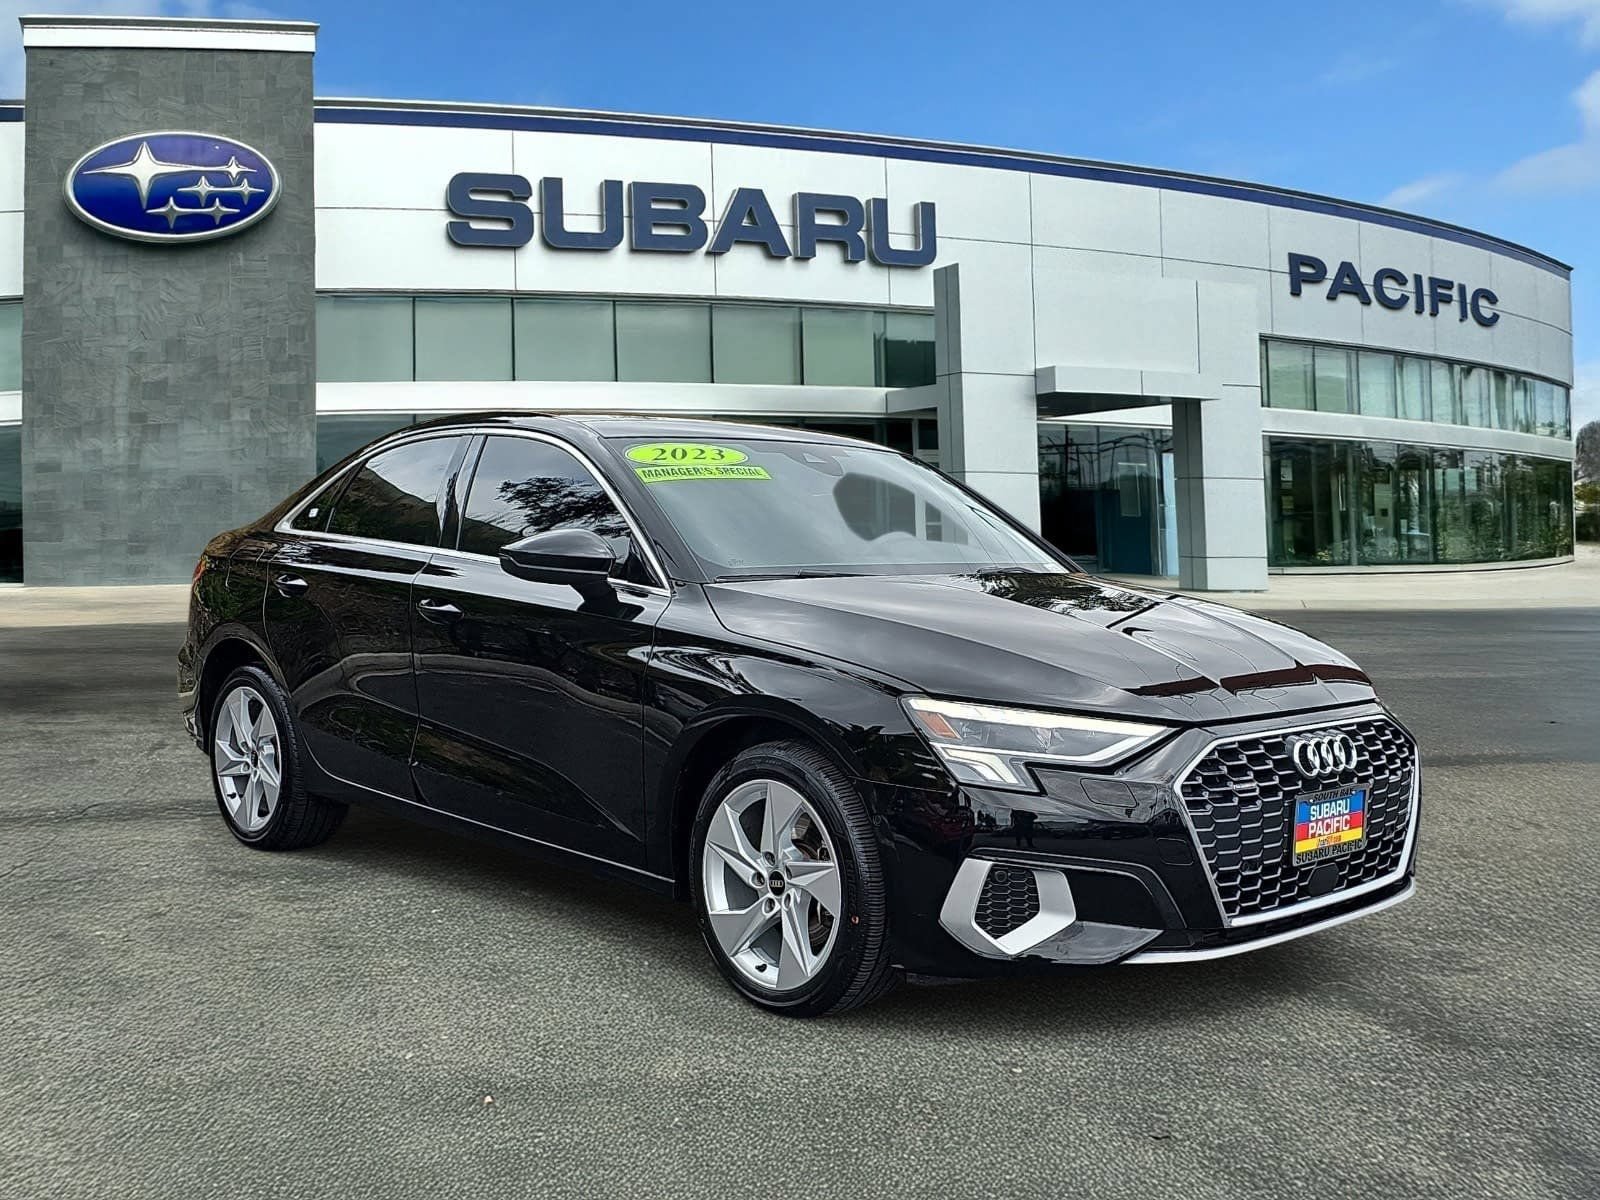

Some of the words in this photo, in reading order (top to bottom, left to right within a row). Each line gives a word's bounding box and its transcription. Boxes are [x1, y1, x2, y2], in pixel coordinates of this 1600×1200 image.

[446, 171, 938, 269] SUBARU
[1287, 251, 1501, 328] PACIFIC
[651, 447, 727, 461] 2023
[715, 466, 762, 476] SPECIAL
[1310, 798, 1350, 821] SUBARU
[1308, 815, 1350, 838] PACIFIC
[1296, 847, 1330, 864] SUBARU
[1332, 839, 1363, 855] PACIFIC
